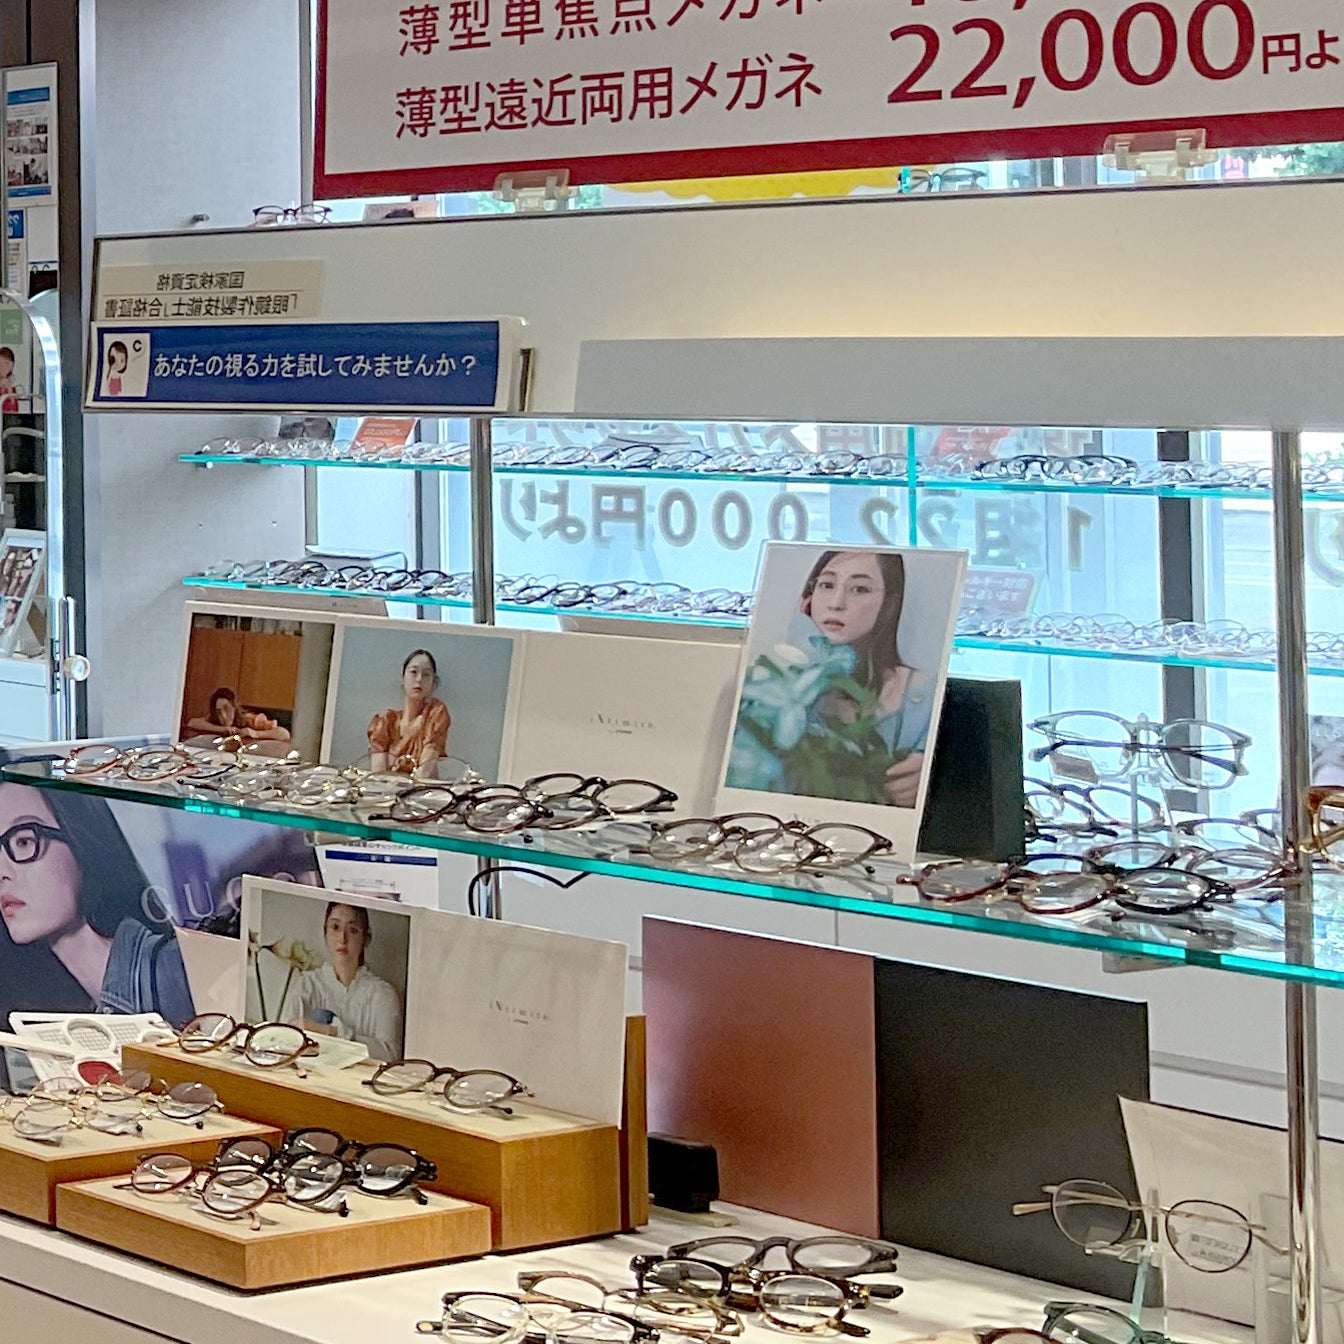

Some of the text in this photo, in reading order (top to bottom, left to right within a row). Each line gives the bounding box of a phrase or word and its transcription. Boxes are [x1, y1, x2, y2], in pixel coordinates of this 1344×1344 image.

[398, 0, 814, 56] 薄型単焦点メ
[395, 52, 823, 139] 薄型遠近両用メガネ
